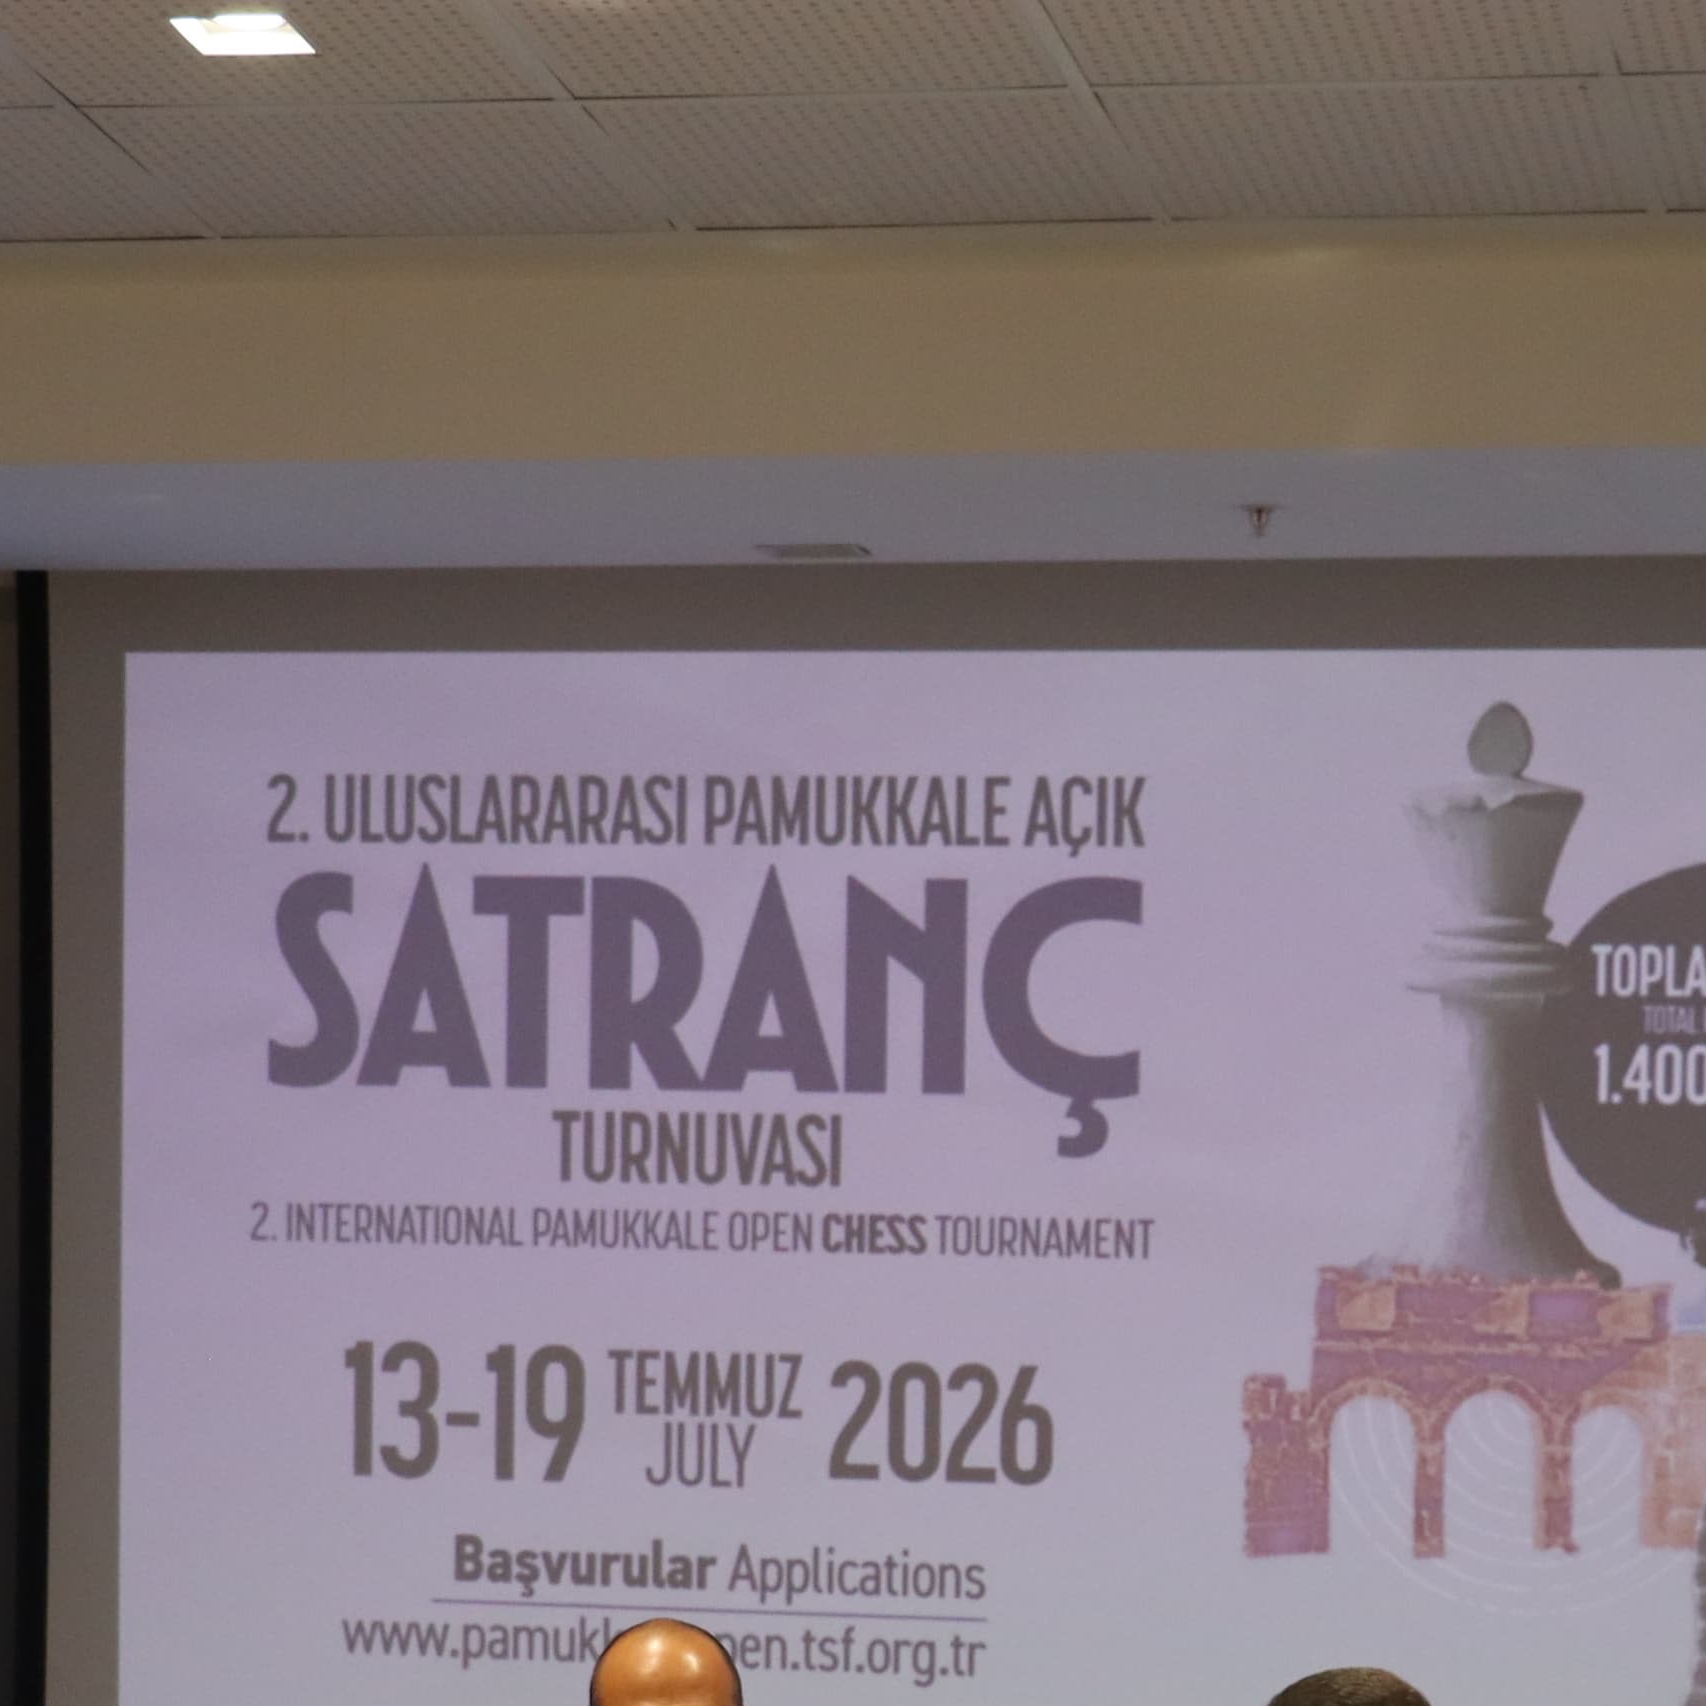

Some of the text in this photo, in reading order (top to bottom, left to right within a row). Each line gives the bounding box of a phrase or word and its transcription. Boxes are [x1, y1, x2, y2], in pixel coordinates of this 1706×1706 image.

[266, 773, 1147, 858] 2. ULUSLARARASI PAMUKKALE AÇIK
[266, 862, 1144, 1158] SATRANÇ
[1643, 1005, 1695, 1034] TOTAL
[551, 1109, 843, 1187] TURNUVASI
[249, 1201, 1156, 1261] 2. INTERNATIONAL PAMUKKALE OPEN CHESS TOURNAMENT
[344, 1340, 1055, 1487] 13-19 TEMMUZ 2026
[644, 1421, 757, 1490] JULY
[453, 1533, 987, 1603] Başvurular Applications
